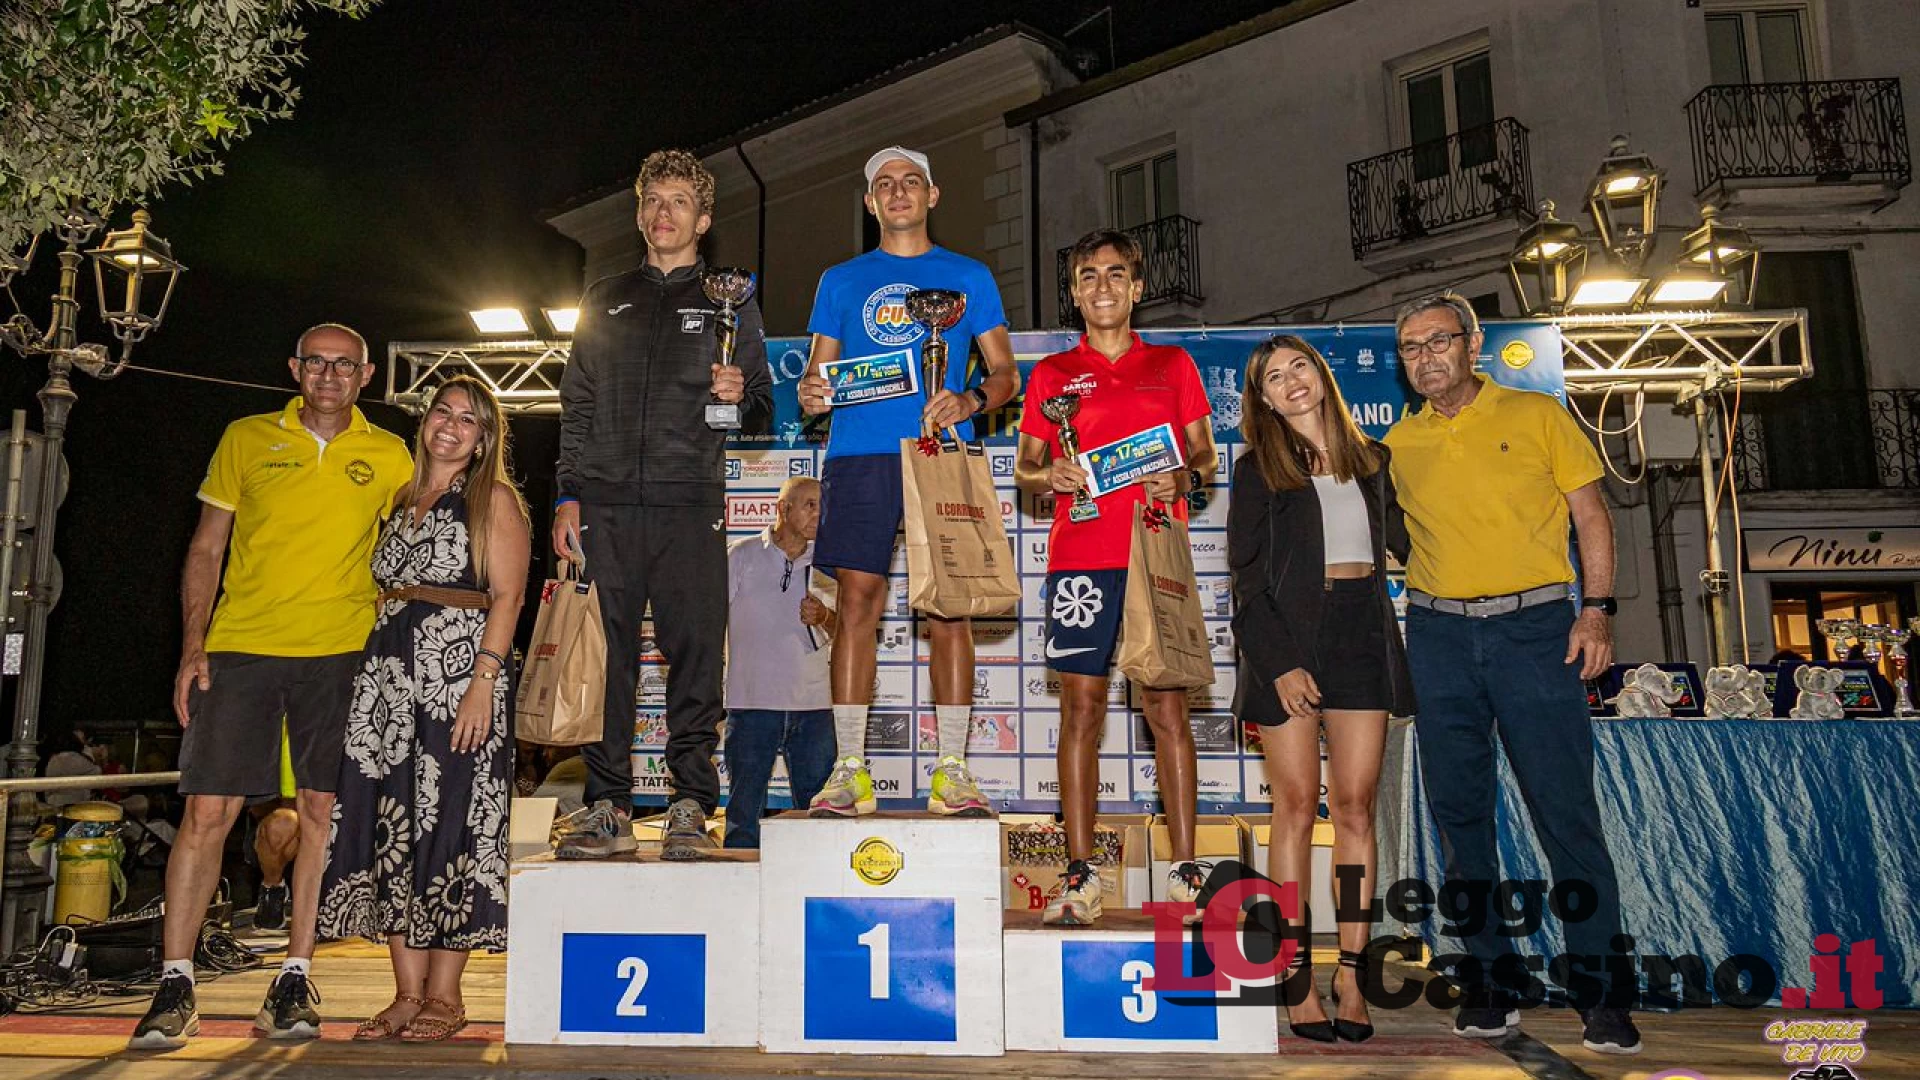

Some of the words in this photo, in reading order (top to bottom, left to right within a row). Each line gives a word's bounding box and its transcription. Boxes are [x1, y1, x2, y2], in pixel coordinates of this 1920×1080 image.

[734, 503, 778, 515] HART
[616, 957, 649, 1016] 2
[858, 924, 889, 999] 1
[1121, 960, 1158, 1023] 3
